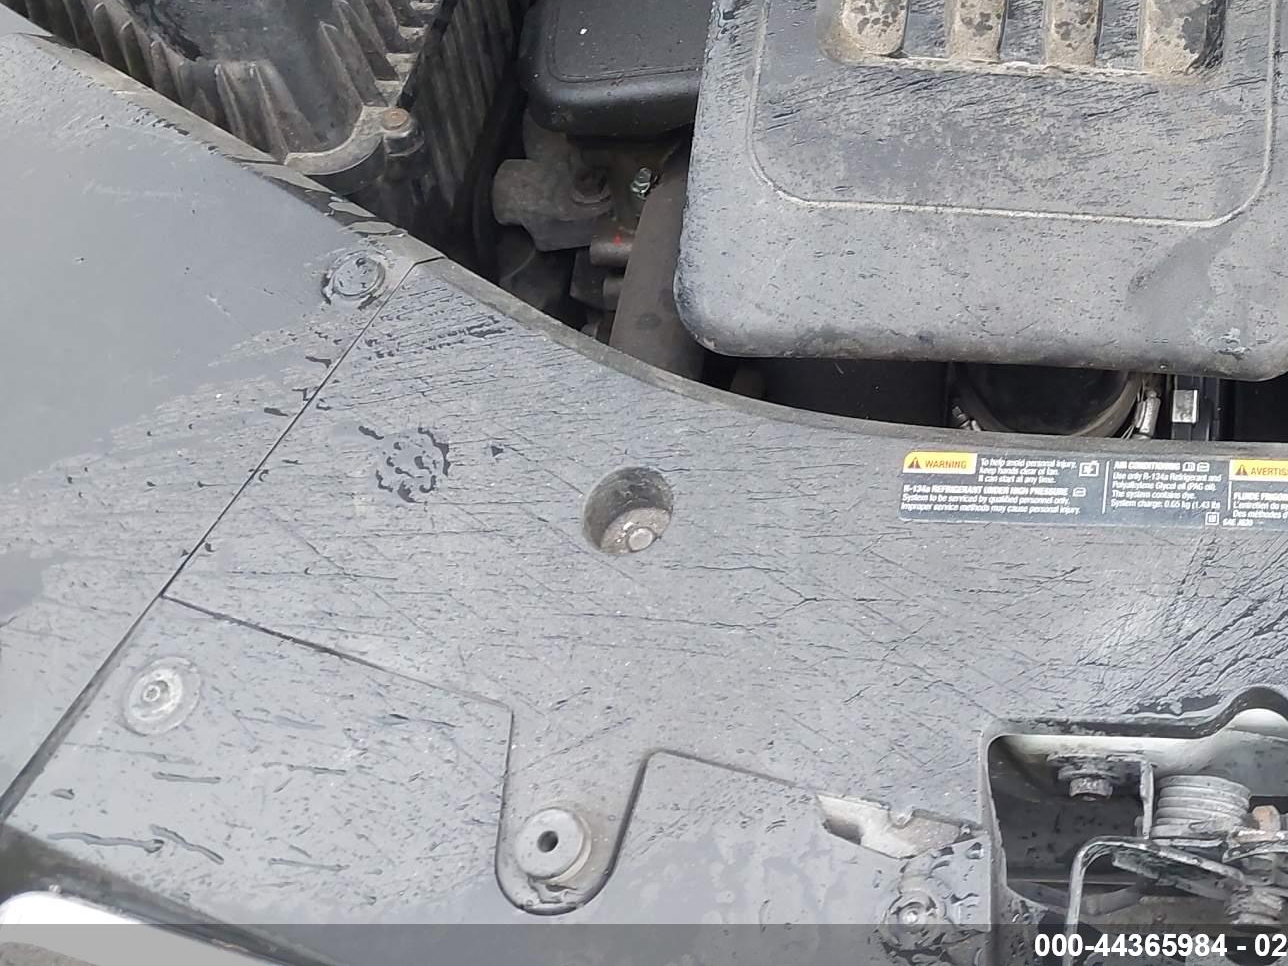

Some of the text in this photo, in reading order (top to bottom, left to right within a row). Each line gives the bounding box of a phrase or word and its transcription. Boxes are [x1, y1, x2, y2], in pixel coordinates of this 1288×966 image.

[926, 460, 967, 470] WARNING
[981, 458, 989, 466] To
[990, 458, 1005, 468] help
[1026, 460, 1055, 469] personal
[1038, 468, 1046, 476] of
[1113, 472, 1221, 483] Use only R-134a Refrigerant and
[903, 485, 1068, 496] R-134a REFRIGERANT UNDER HIGH PRESSURE
[1155, 482, 1176, 491] Glycol
[902, 494, 928, 503] System
[929, 494, 937, 502] to
[948, 495, 977, 503] serviced
[978, 495, 988, 504] by
[988, 495, 1018, 505] qualified
[1019, 497, 1052, 505] personnel
[1112, 490, 1125, 498] The
[1126, 491, 1151, 499] system
[1152, 491, 1181, 499] contains
[901, 502, 932, 512] Improper
[933, 503, 958, 511] service
[959, 504, 990, 512] methods
[991, 504, 1006, 514] may
[1007, 505, 1028, 513] cause
[1029, 505, 1059, 514] personal
[1111, 499, 1137, 508] System
[1181, 501, 1191, 509] kg
